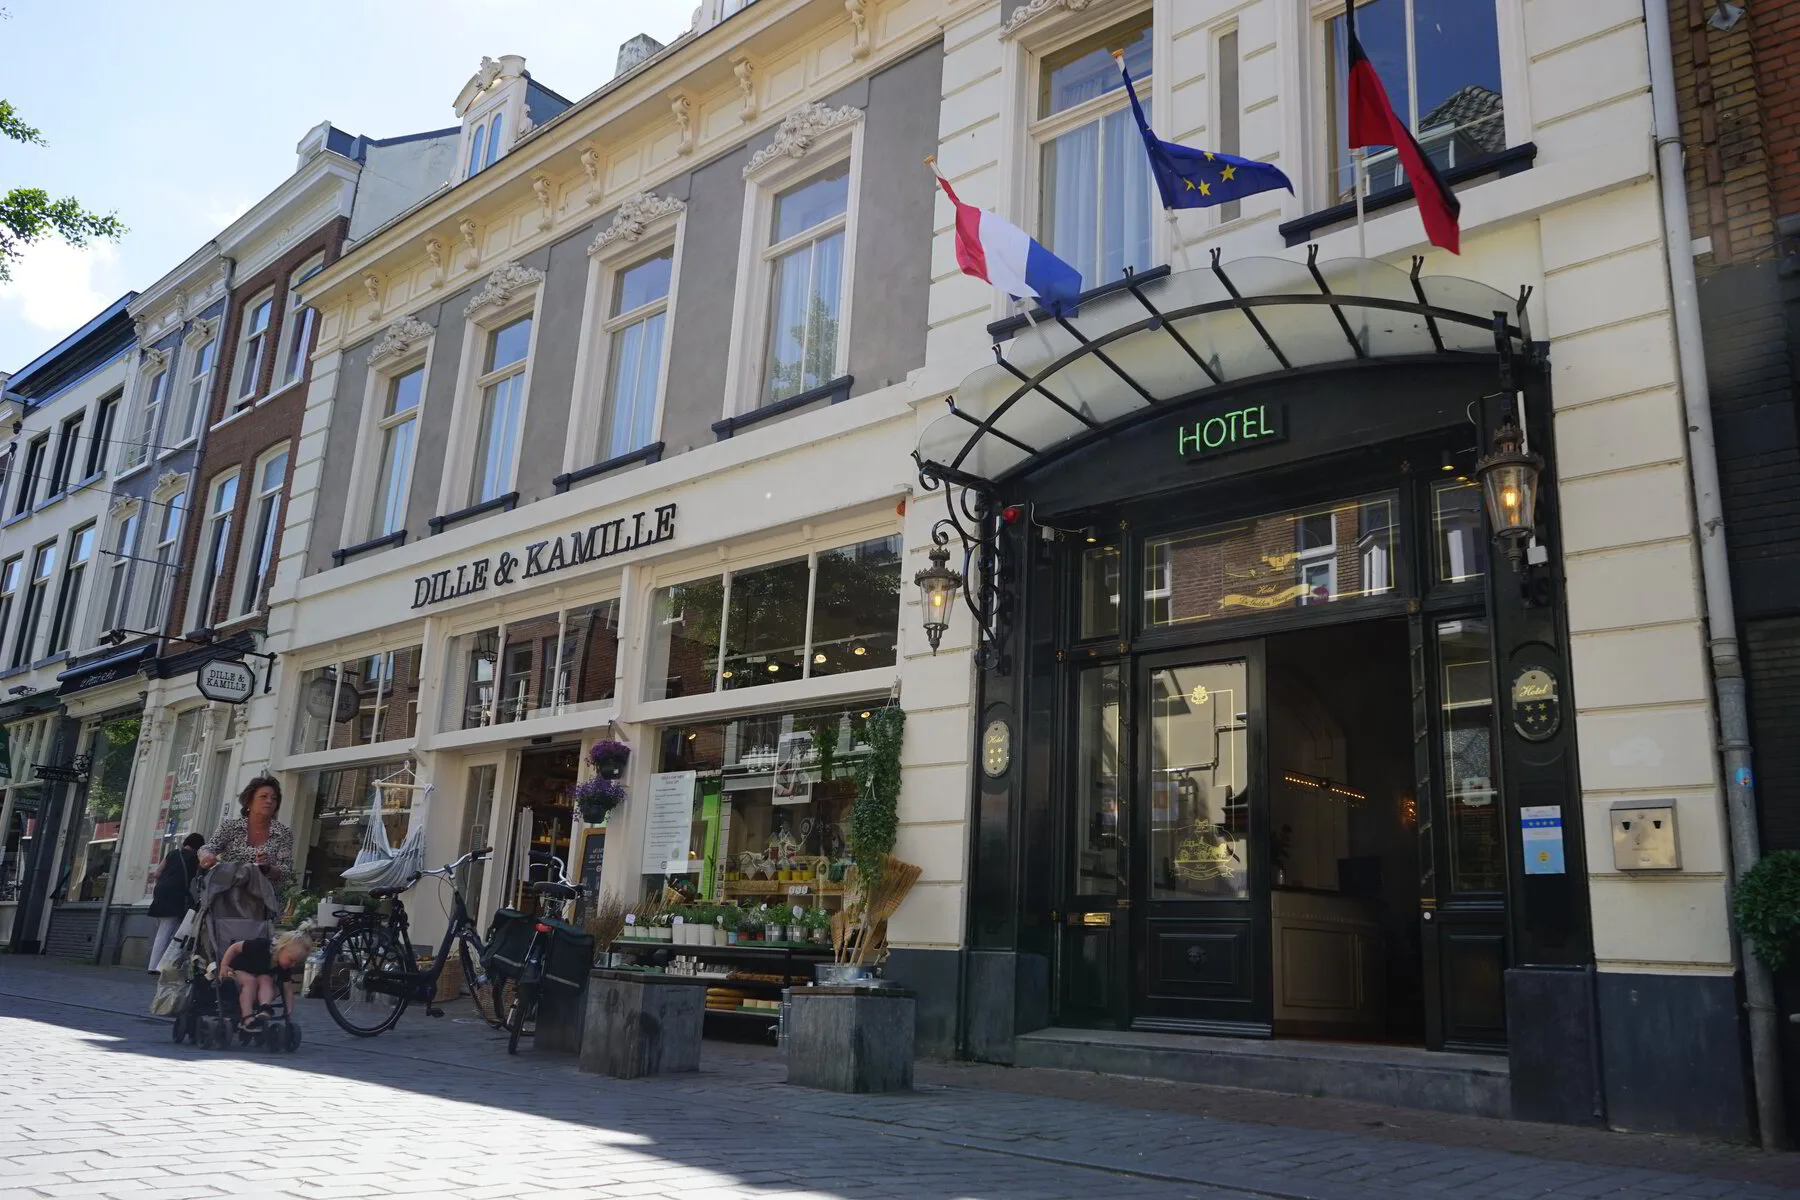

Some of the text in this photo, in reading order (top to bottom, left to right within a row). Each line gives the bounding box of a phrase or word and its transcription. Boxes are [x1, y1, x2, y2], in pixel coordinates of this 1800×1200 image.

[1179, 405, 1275, 455] HOTEL
[411, 503, 677, 609] DILLE & KAMILLE
[210, 670, 245, 683] DILLE &
[206, 678, 247, 692] KAMILLE
[1519, 684, 1549, 697] Hotel
